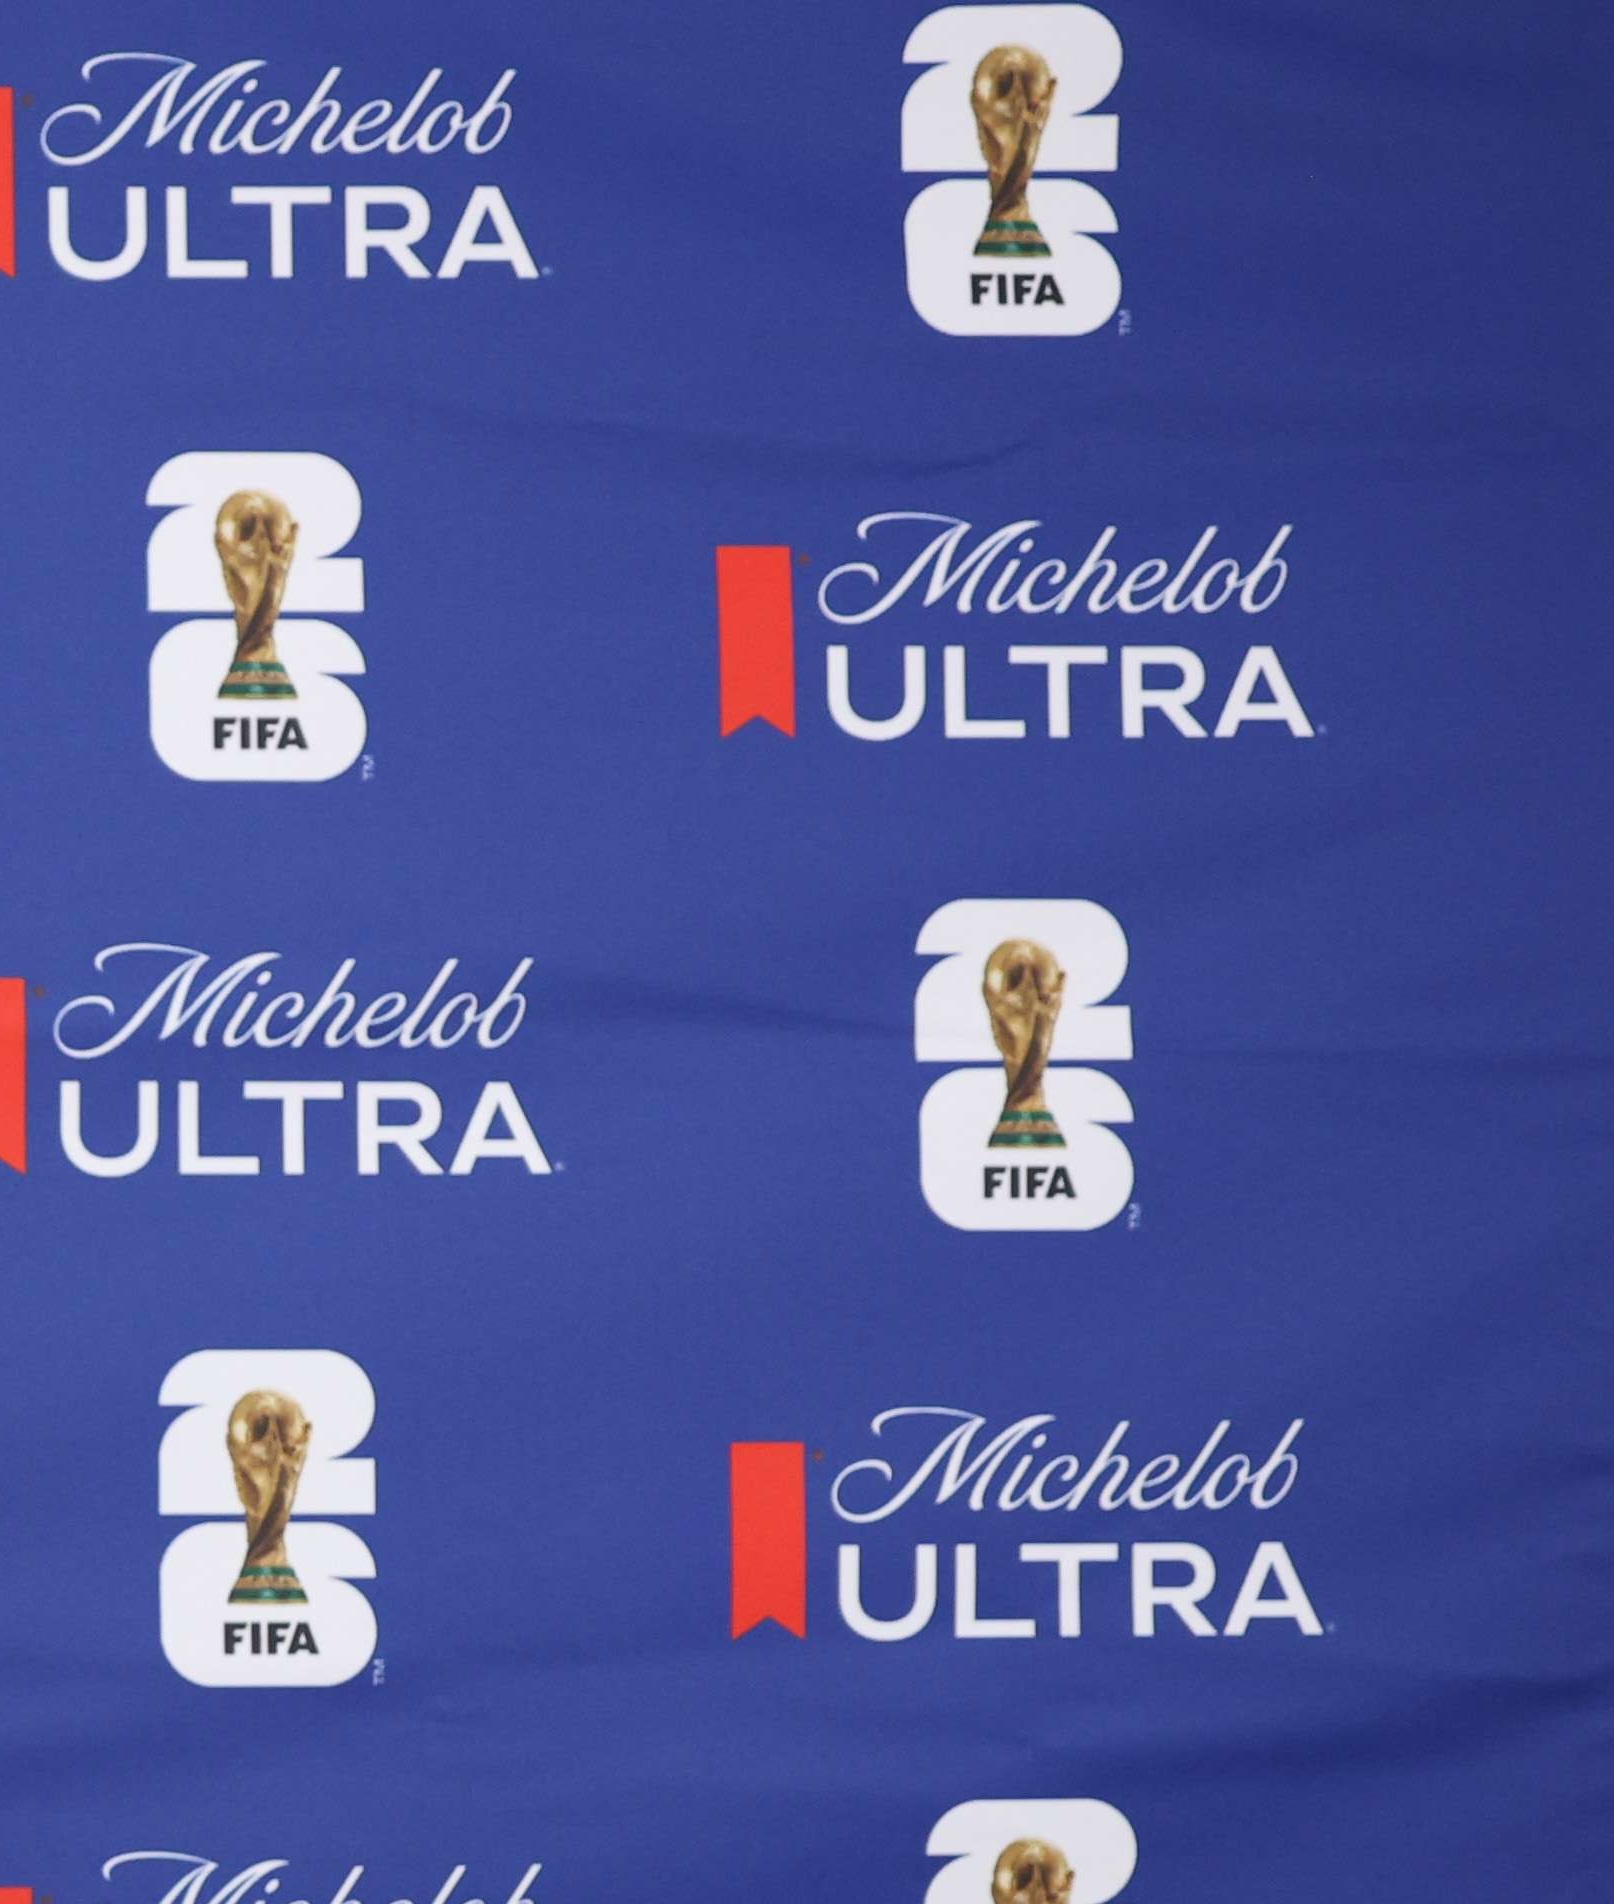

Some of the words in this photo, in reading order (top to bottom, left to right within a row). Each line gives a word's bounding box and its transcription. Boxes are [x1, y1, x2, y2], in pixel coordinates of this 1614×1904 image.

[41, 53, 516, 165] Michelob
[48, 186, 538, 281] ULTRA
[970, 273, 1065, 306] FIFA
[818, 513, 1290, 624] Michelob
[213, 717, 308, 750] FIFA
[827, 646, 1313, 741] ULTRA
[54, 943, 532, 1058] Michelob
[60, 1081, 551, 1177] ULTRA
[983, 1166, 1076, 1199] FIFA
[832, 1407, 1302, 1523] Michelob
[223, 1622, 319, 1655] FIFA
[839, 1542, 1322, 1641] ULTRA
